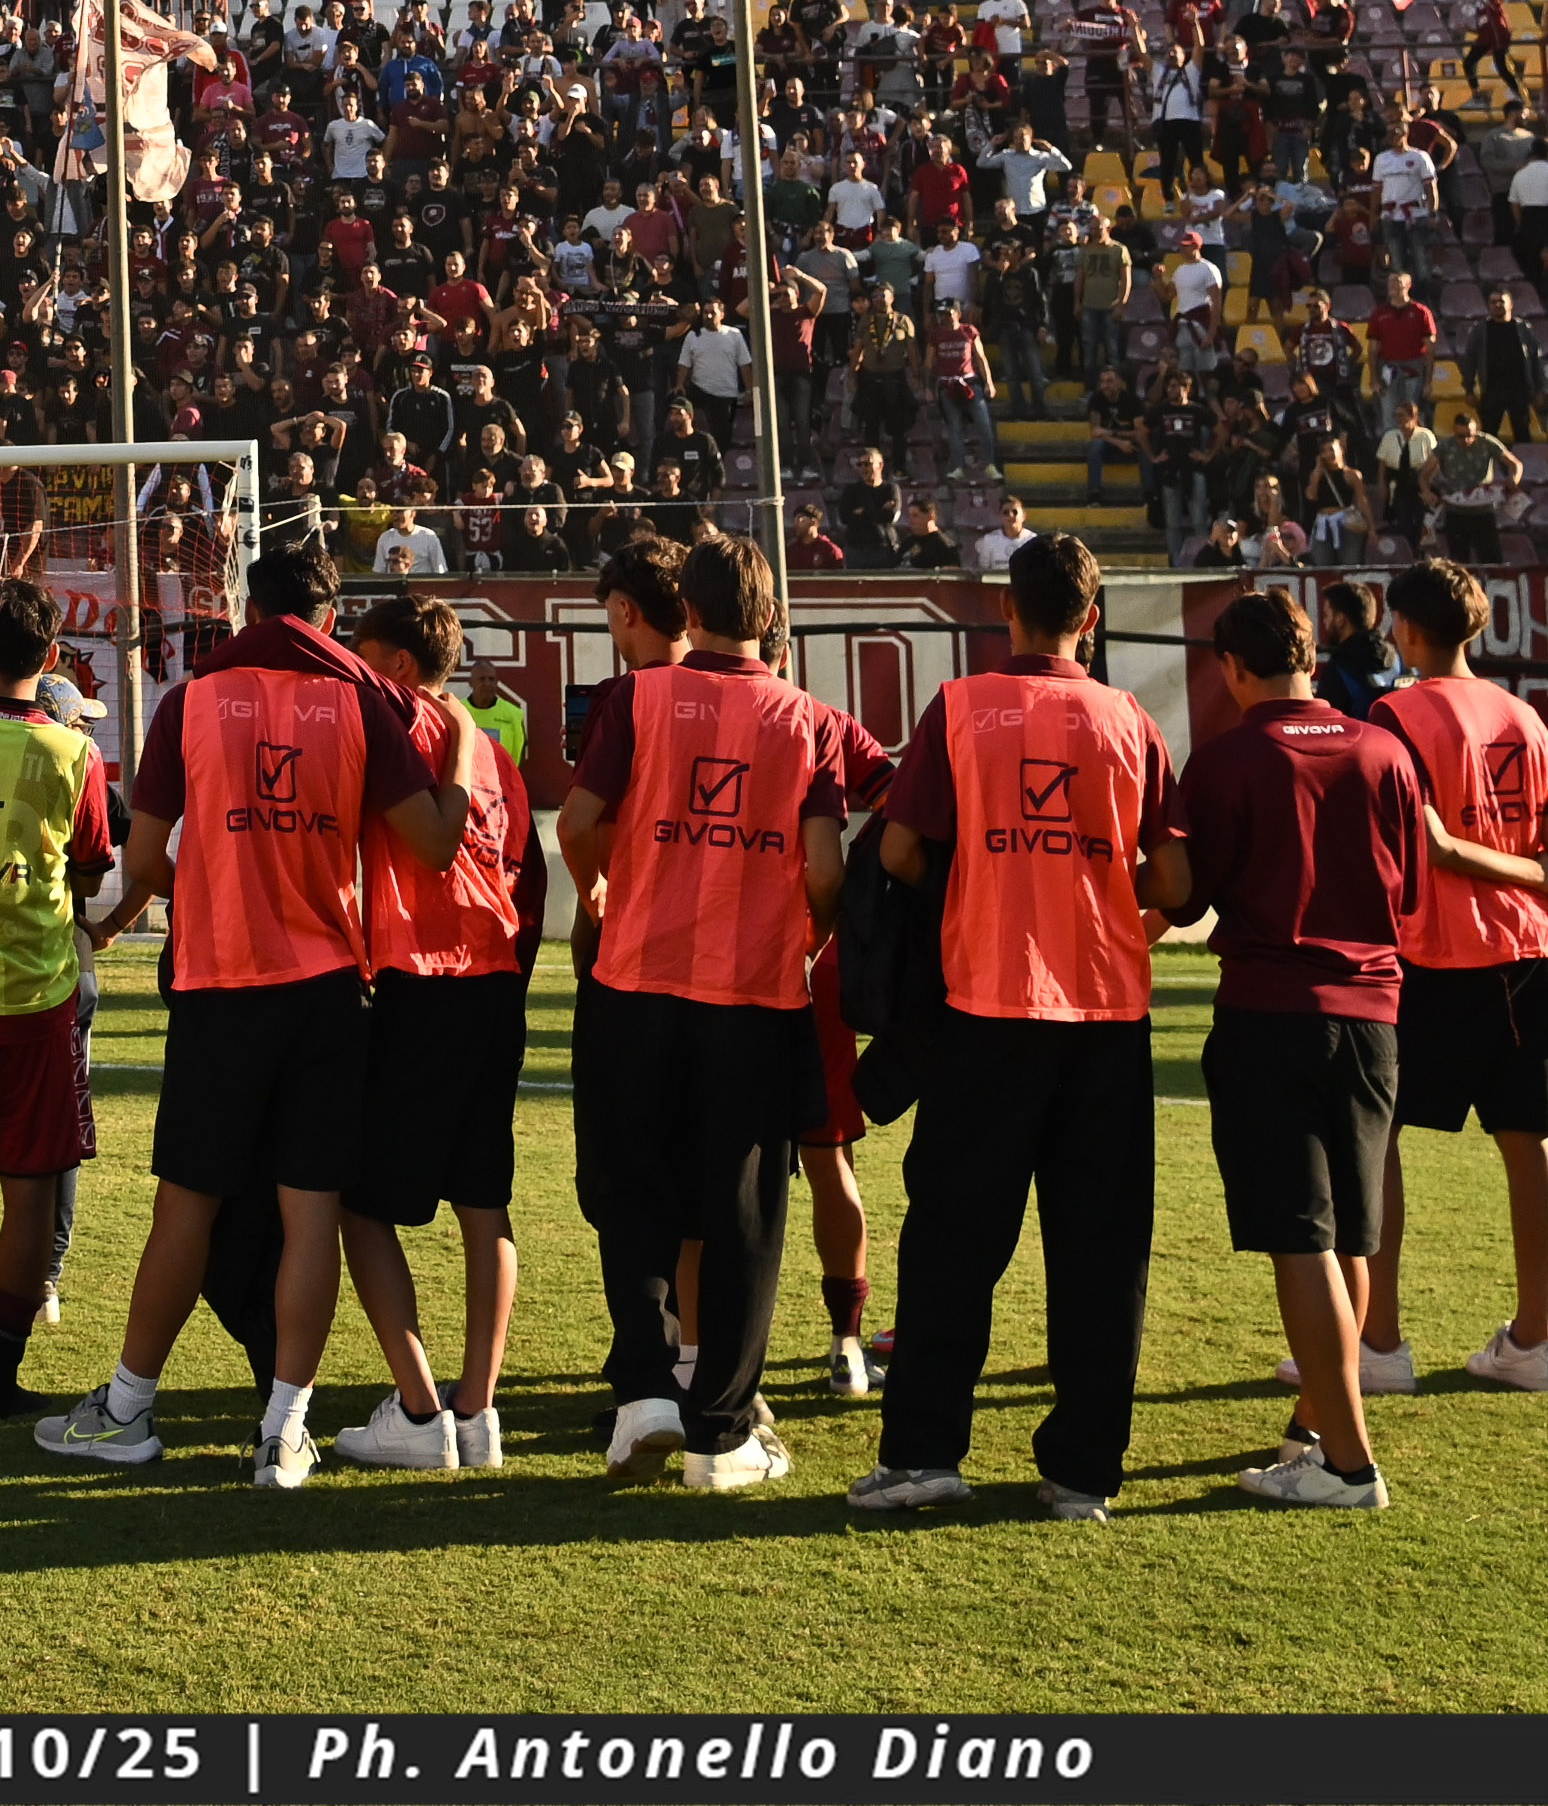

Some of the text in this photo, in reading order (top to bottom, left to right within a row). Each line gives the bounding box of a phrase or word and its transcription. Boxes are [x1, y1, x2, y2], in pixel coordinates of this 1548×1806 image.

[1282, 724, 1345, 736] GIVOVA
[227, 806, 340, 837] GIVOVA
[654, 819, 784, 855] GIVOVA
[985, 828, 1114, 863] GIVOVA
